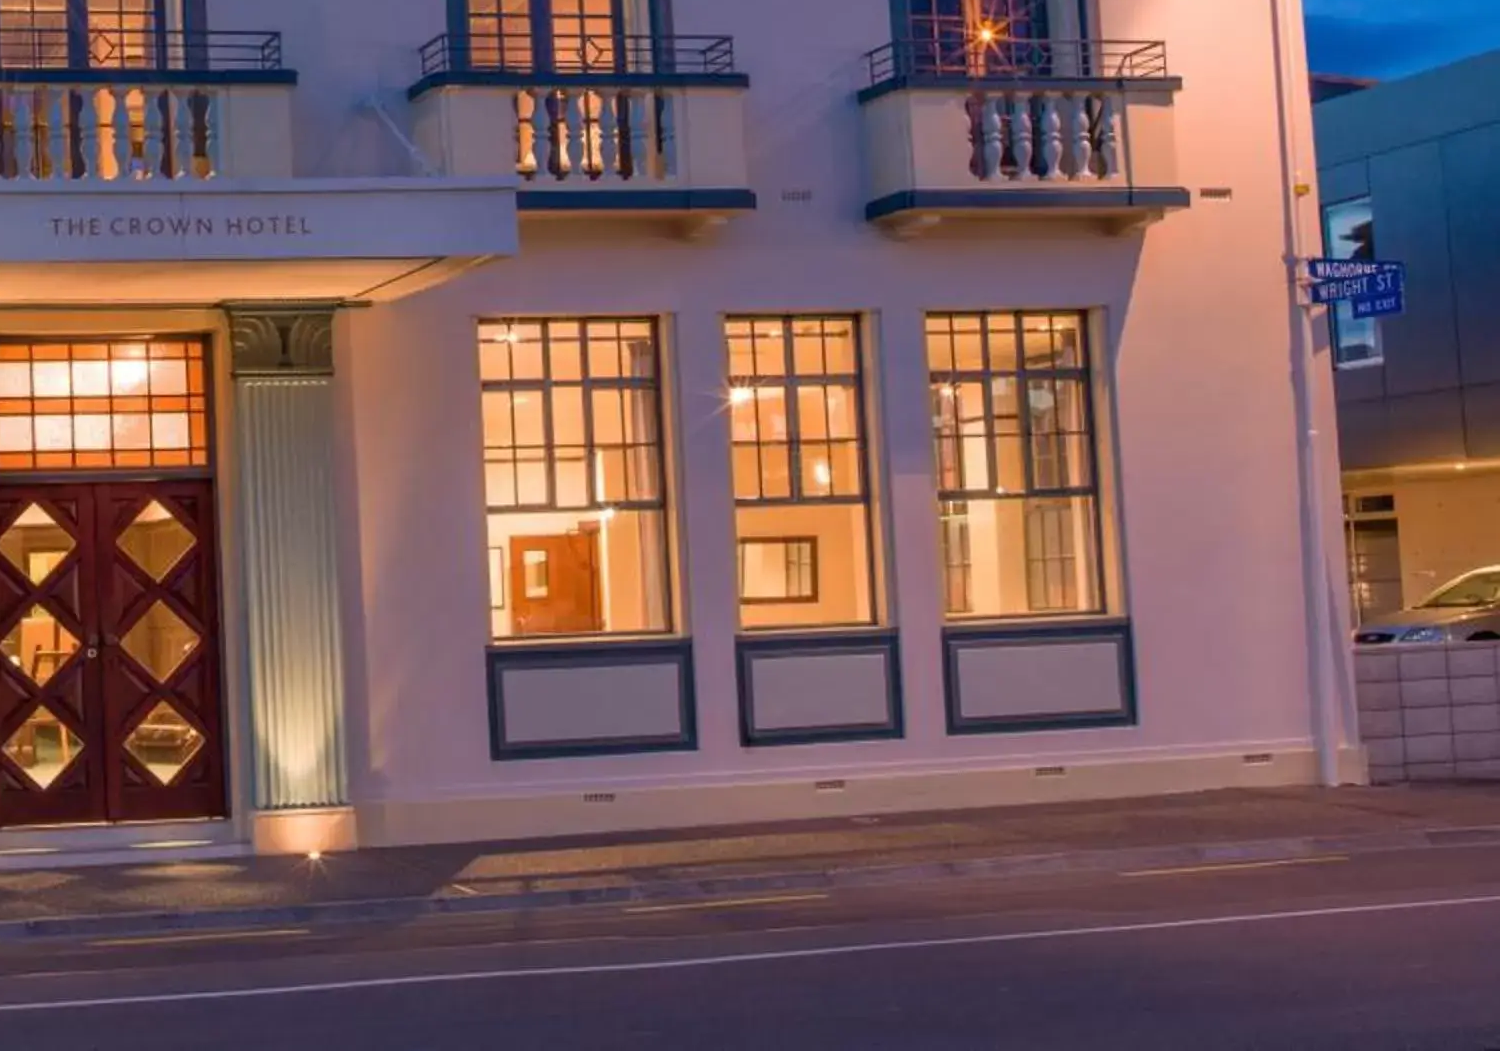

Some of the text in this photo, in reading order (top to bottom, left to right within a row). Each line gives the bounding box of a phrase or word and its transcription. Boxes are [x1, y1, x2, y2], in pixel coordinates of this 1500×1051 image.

[51, 214, 313, 237] THE CROWN HOTEL
[1318, 272, 1393, 299] WRIGHT ST
